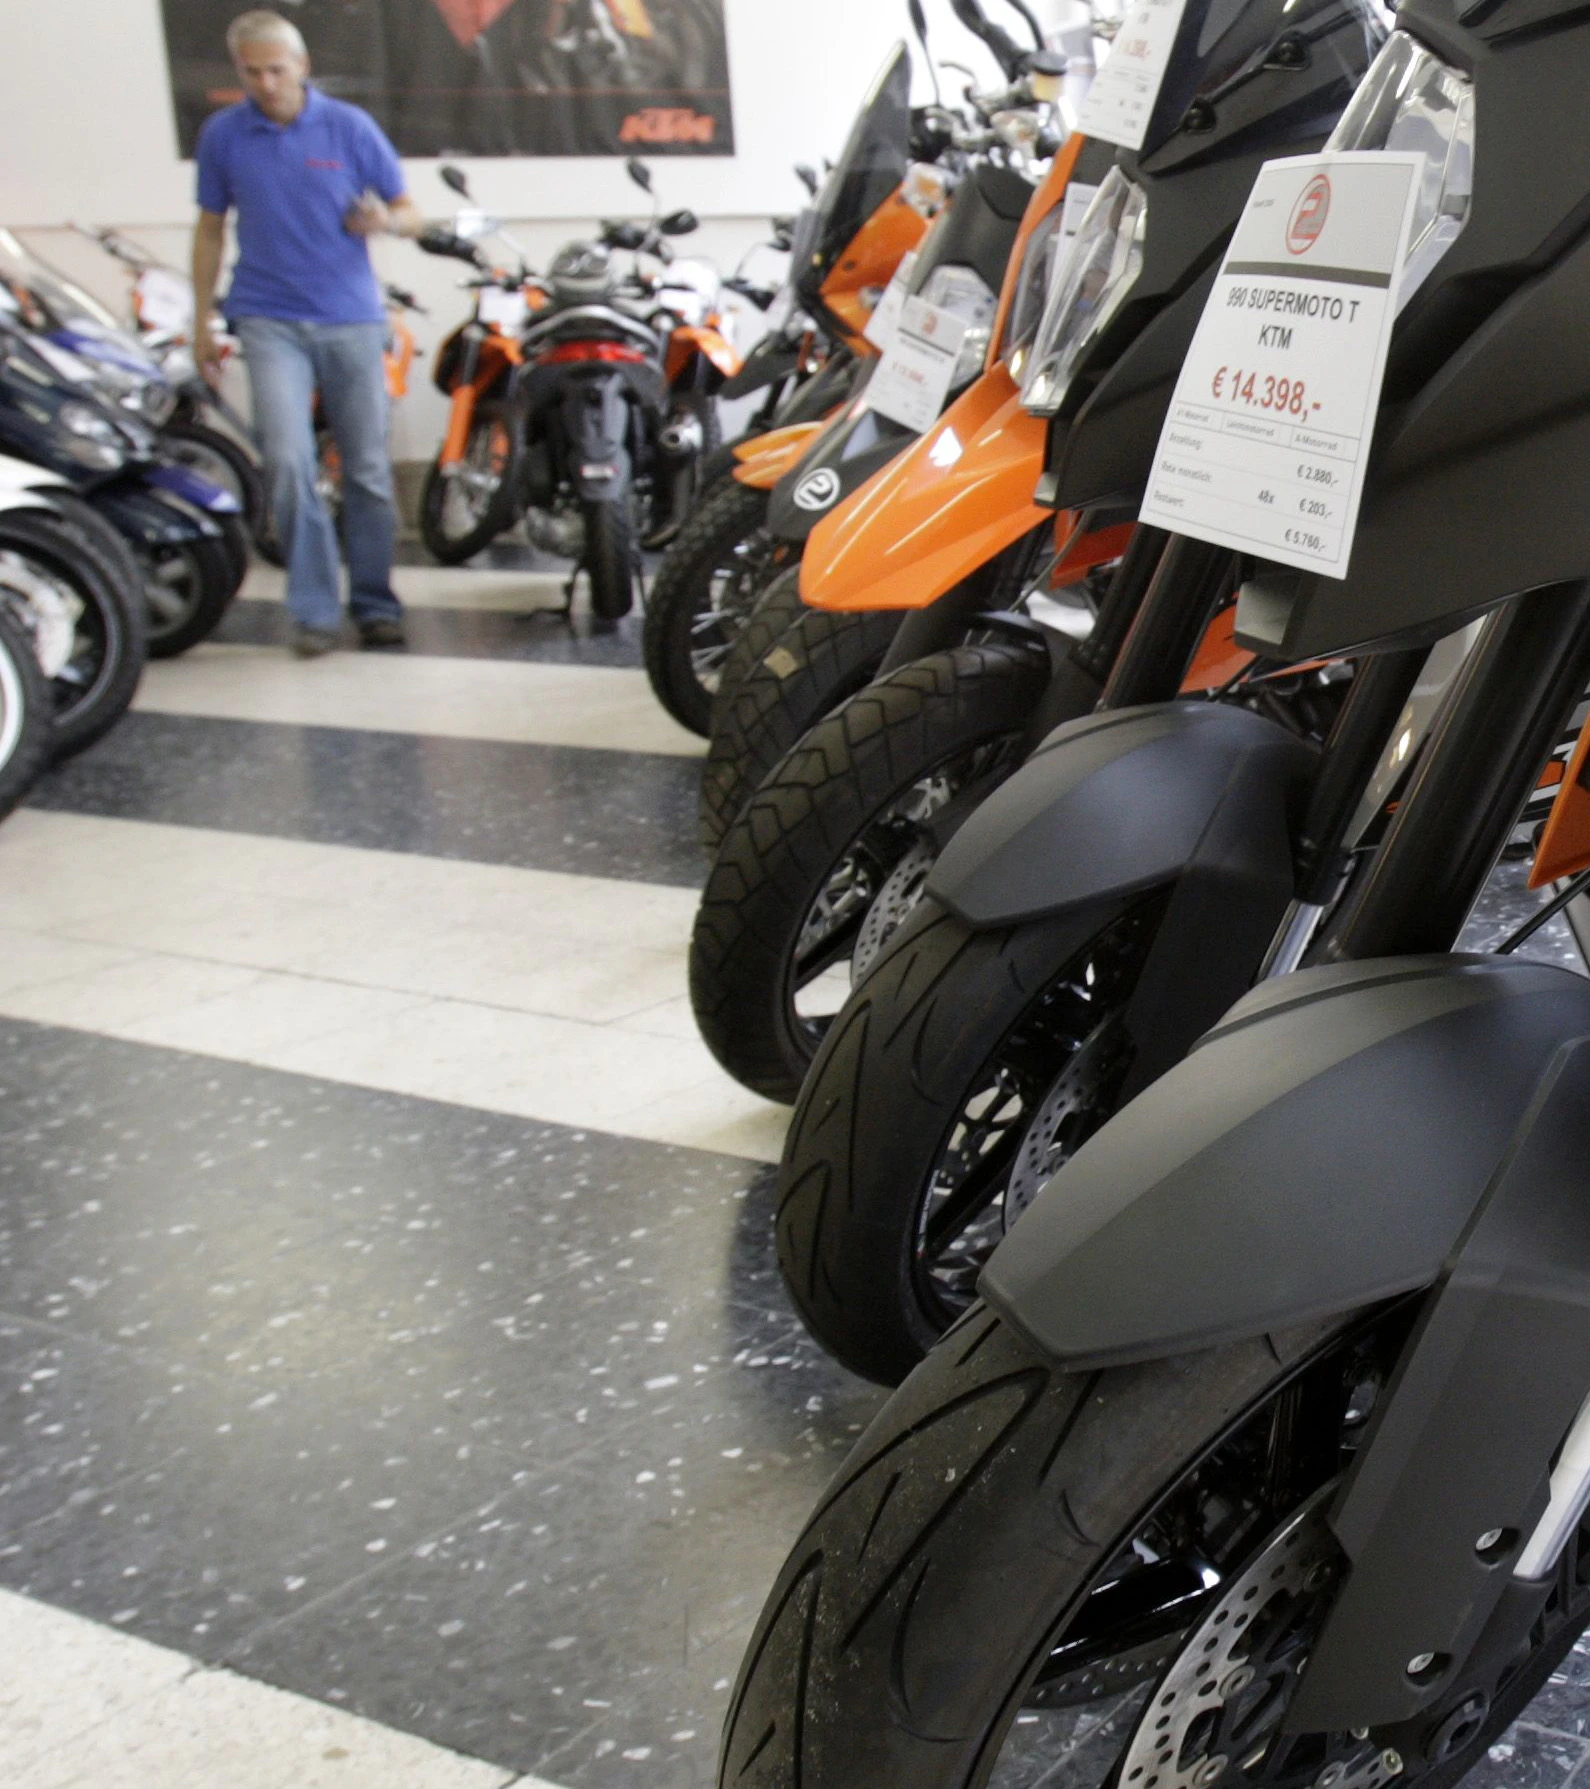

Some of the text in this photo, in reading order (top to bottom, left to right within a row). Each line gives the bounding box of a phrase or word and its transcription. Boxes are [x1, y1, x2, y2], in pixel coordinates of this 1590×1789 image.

[1226, 286, 1360, 324] 990 SUPERMOTO T
[1258, 323, 1293, 349] KTM
[1211, 366, 1322, 423] € 14.398,-
